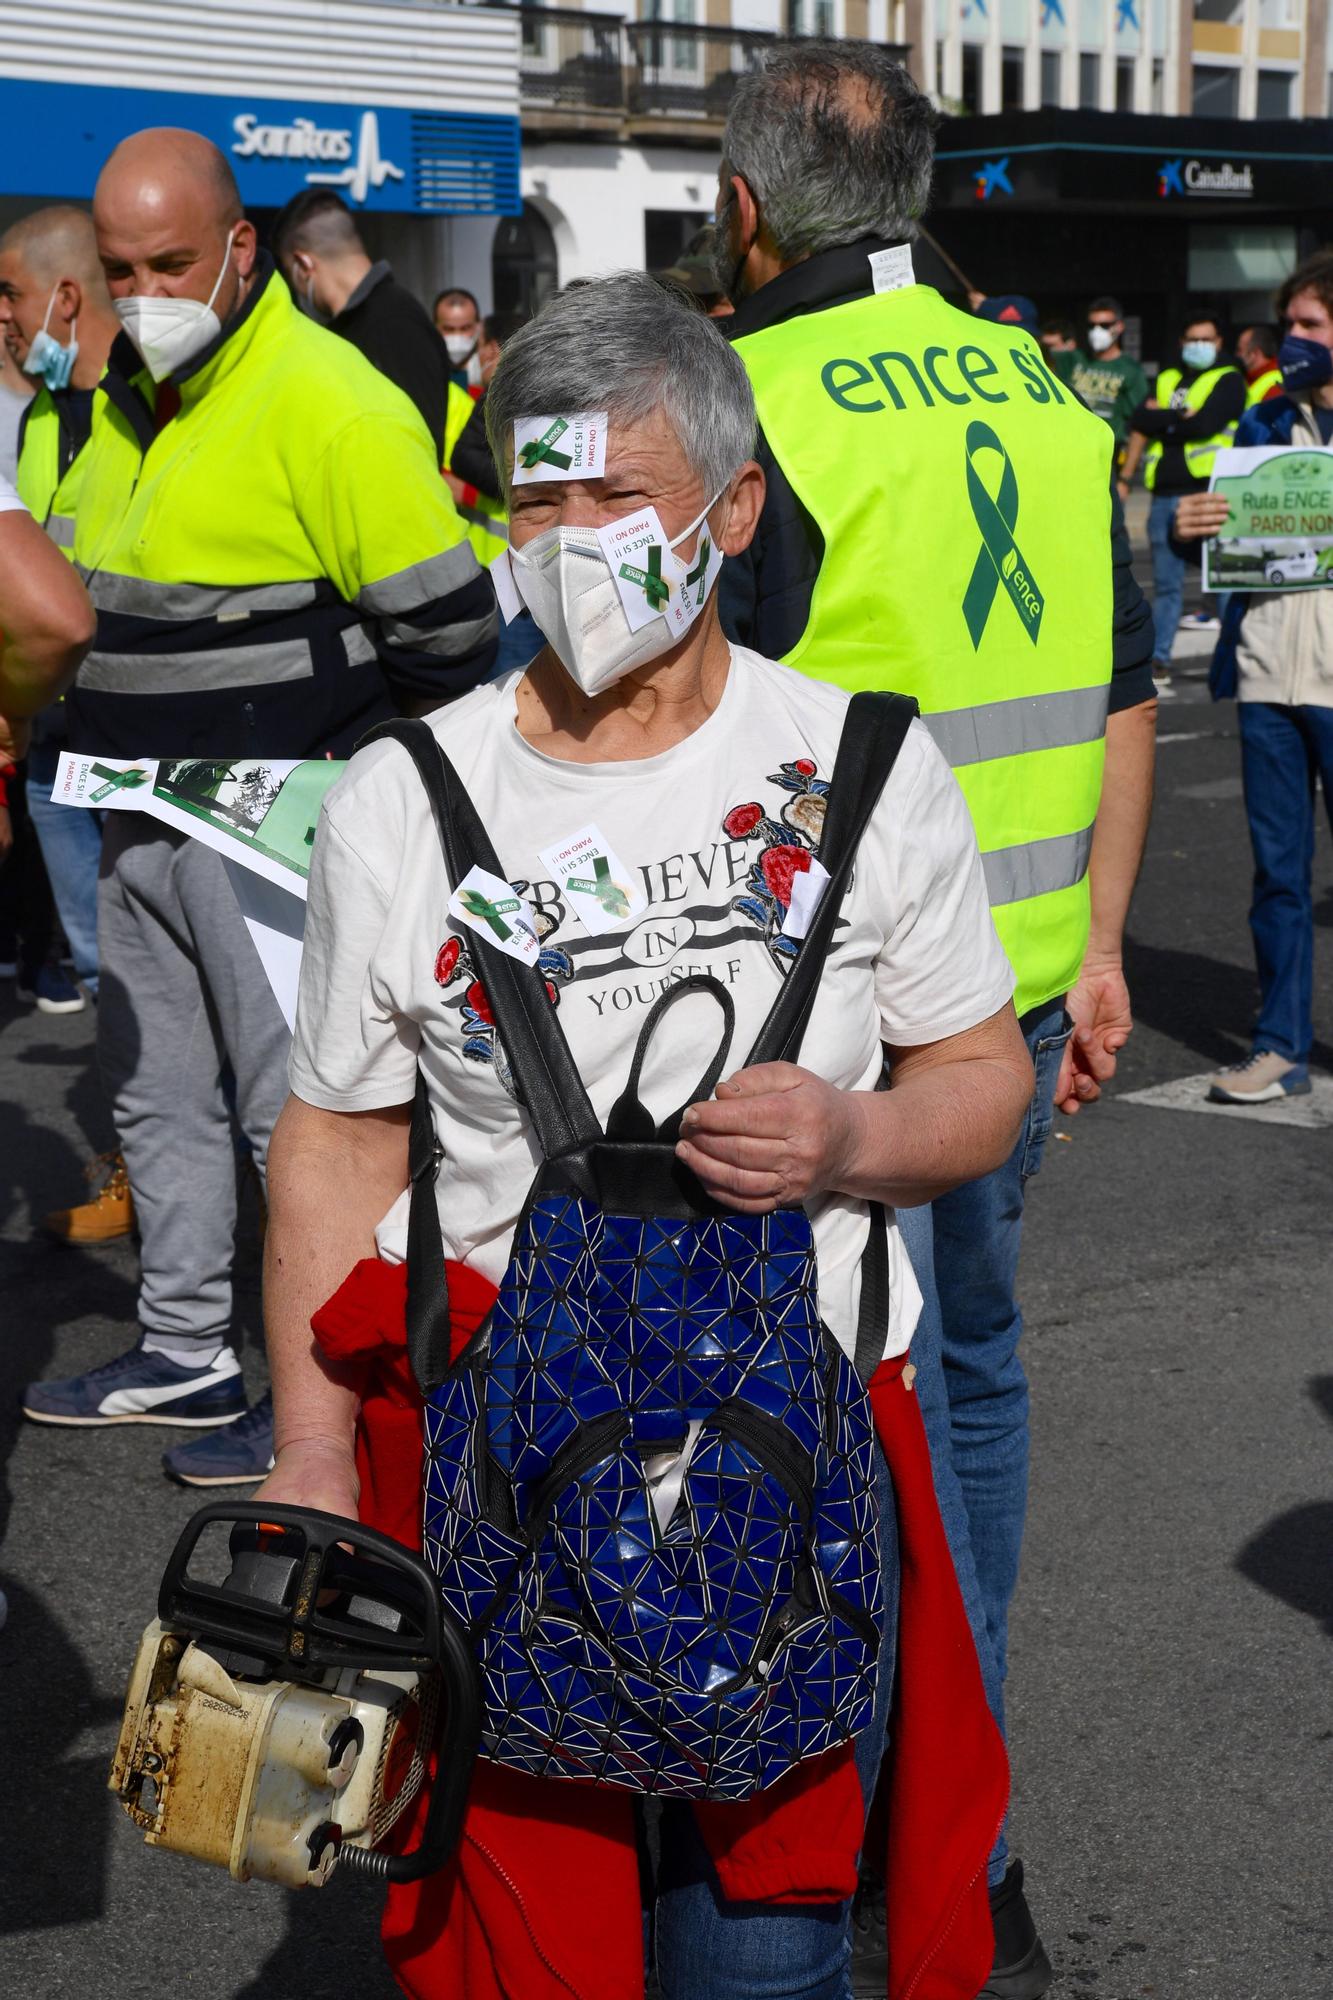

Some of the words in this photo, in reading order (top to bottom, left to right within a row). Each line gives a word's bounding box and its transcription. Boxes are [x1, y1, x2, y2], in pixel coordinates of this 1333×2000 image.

[231, 113, 352, 160] Sanitas
[1184, 160, 1254, 190] CaixaBank
[821, 345, 1010, 413] ence
[575, 432, 583, 441] SI
[589, 430, 597, 442] NO
[574, 442, 583, 467] ENCE
[588, 444, 596, 467] PARO
[1242, 491, 1278, 510] Ruta
[1283, 490, 1332, 510] ENCE
[629, 520, 650, 534] PARO
[1250, 514, 1296, 534] PARO
[616, 530, 628, 541] NO
[632, 534, 656, 550] ENCE
[622, 544, 632, 554] SI
[1014, 571, 1040, 618] ence
[66, 761, 76, 780] PARO
[79, 763, 90, 783] ENCE
[63, 781, 71, 792] NO
[559, 849, 571, 859] NO
[571, 837, 592, 852] PARO
[567, 860, 577, 870] SI
[577, 848, 599, 864] ENCE
[531, 840, 751, 924] BIEVE
[511, 924, 528, 945] ENCE
[523, 935, 537, 953] PAR
[644, 926, 679, 958] IN
